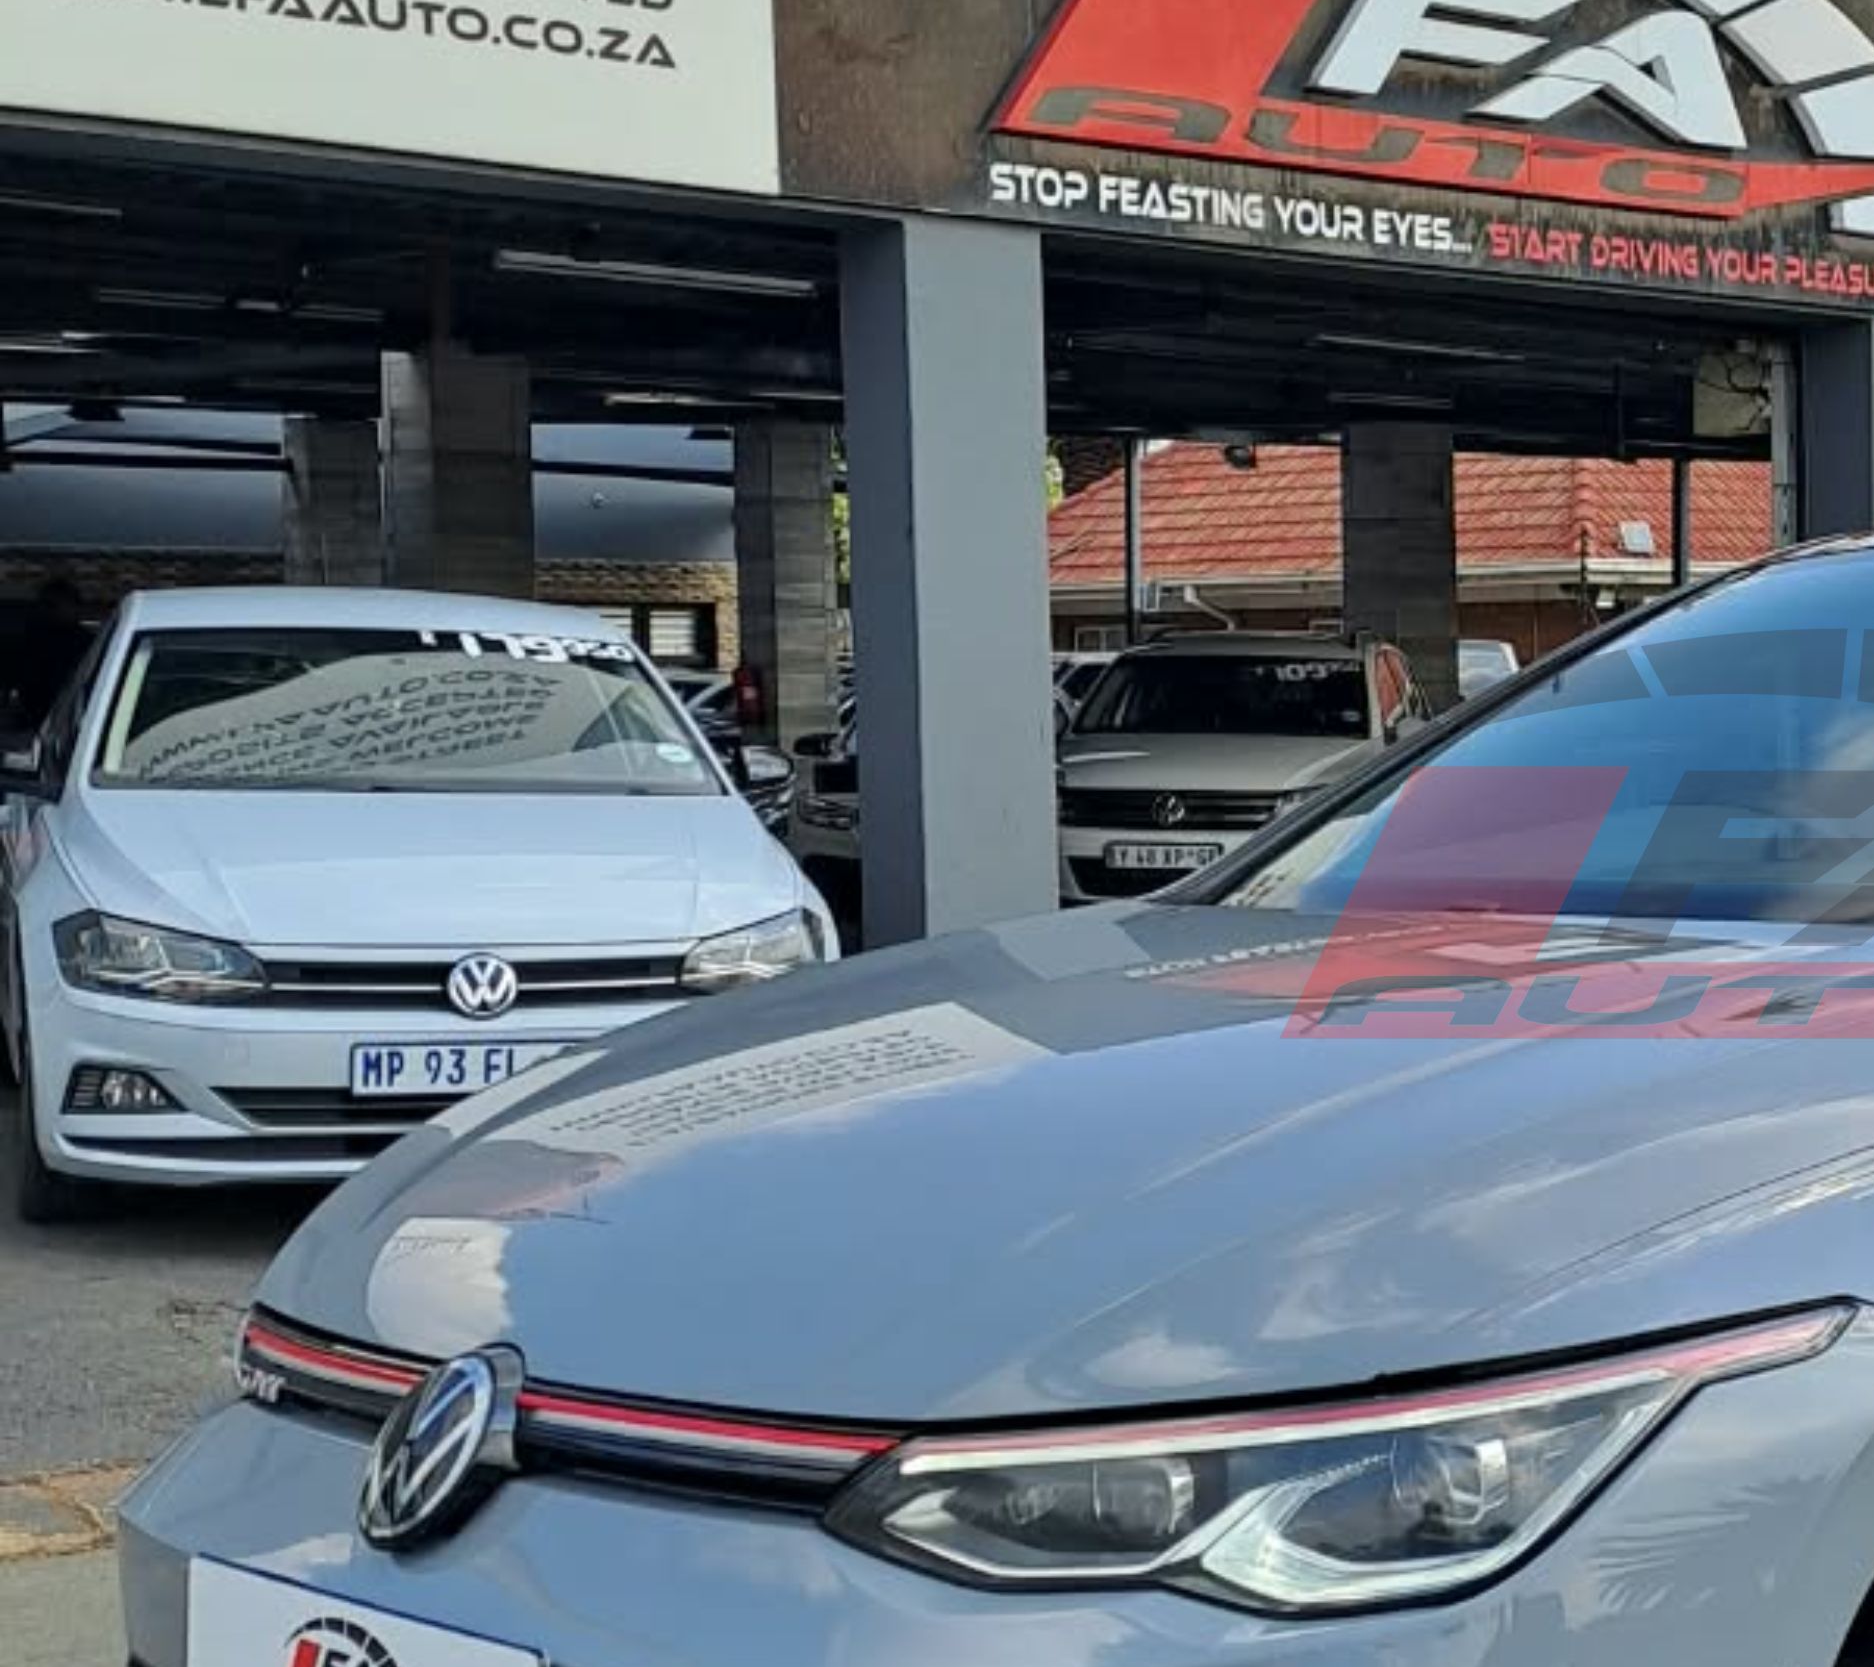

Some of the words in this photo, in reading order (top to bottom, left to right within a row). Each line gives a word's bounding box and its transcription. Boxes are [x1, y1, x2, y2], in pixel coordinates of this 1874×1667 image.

[1024, 85, 1748, 204] AUTO
[989, 162, 1088, 210] STOP
[1099, 176, 1264, 228] FEASTING
[1273, 195, 1365, 243] YOUR
[1487, 222, 1584, 264] START
[1589, 235, 1699, 279] DRIVING
[1706, 247, 1778, 286] YOUR
[362, 1050, 405, 1088] MP
[425, 1048, 467, 1085] 93
